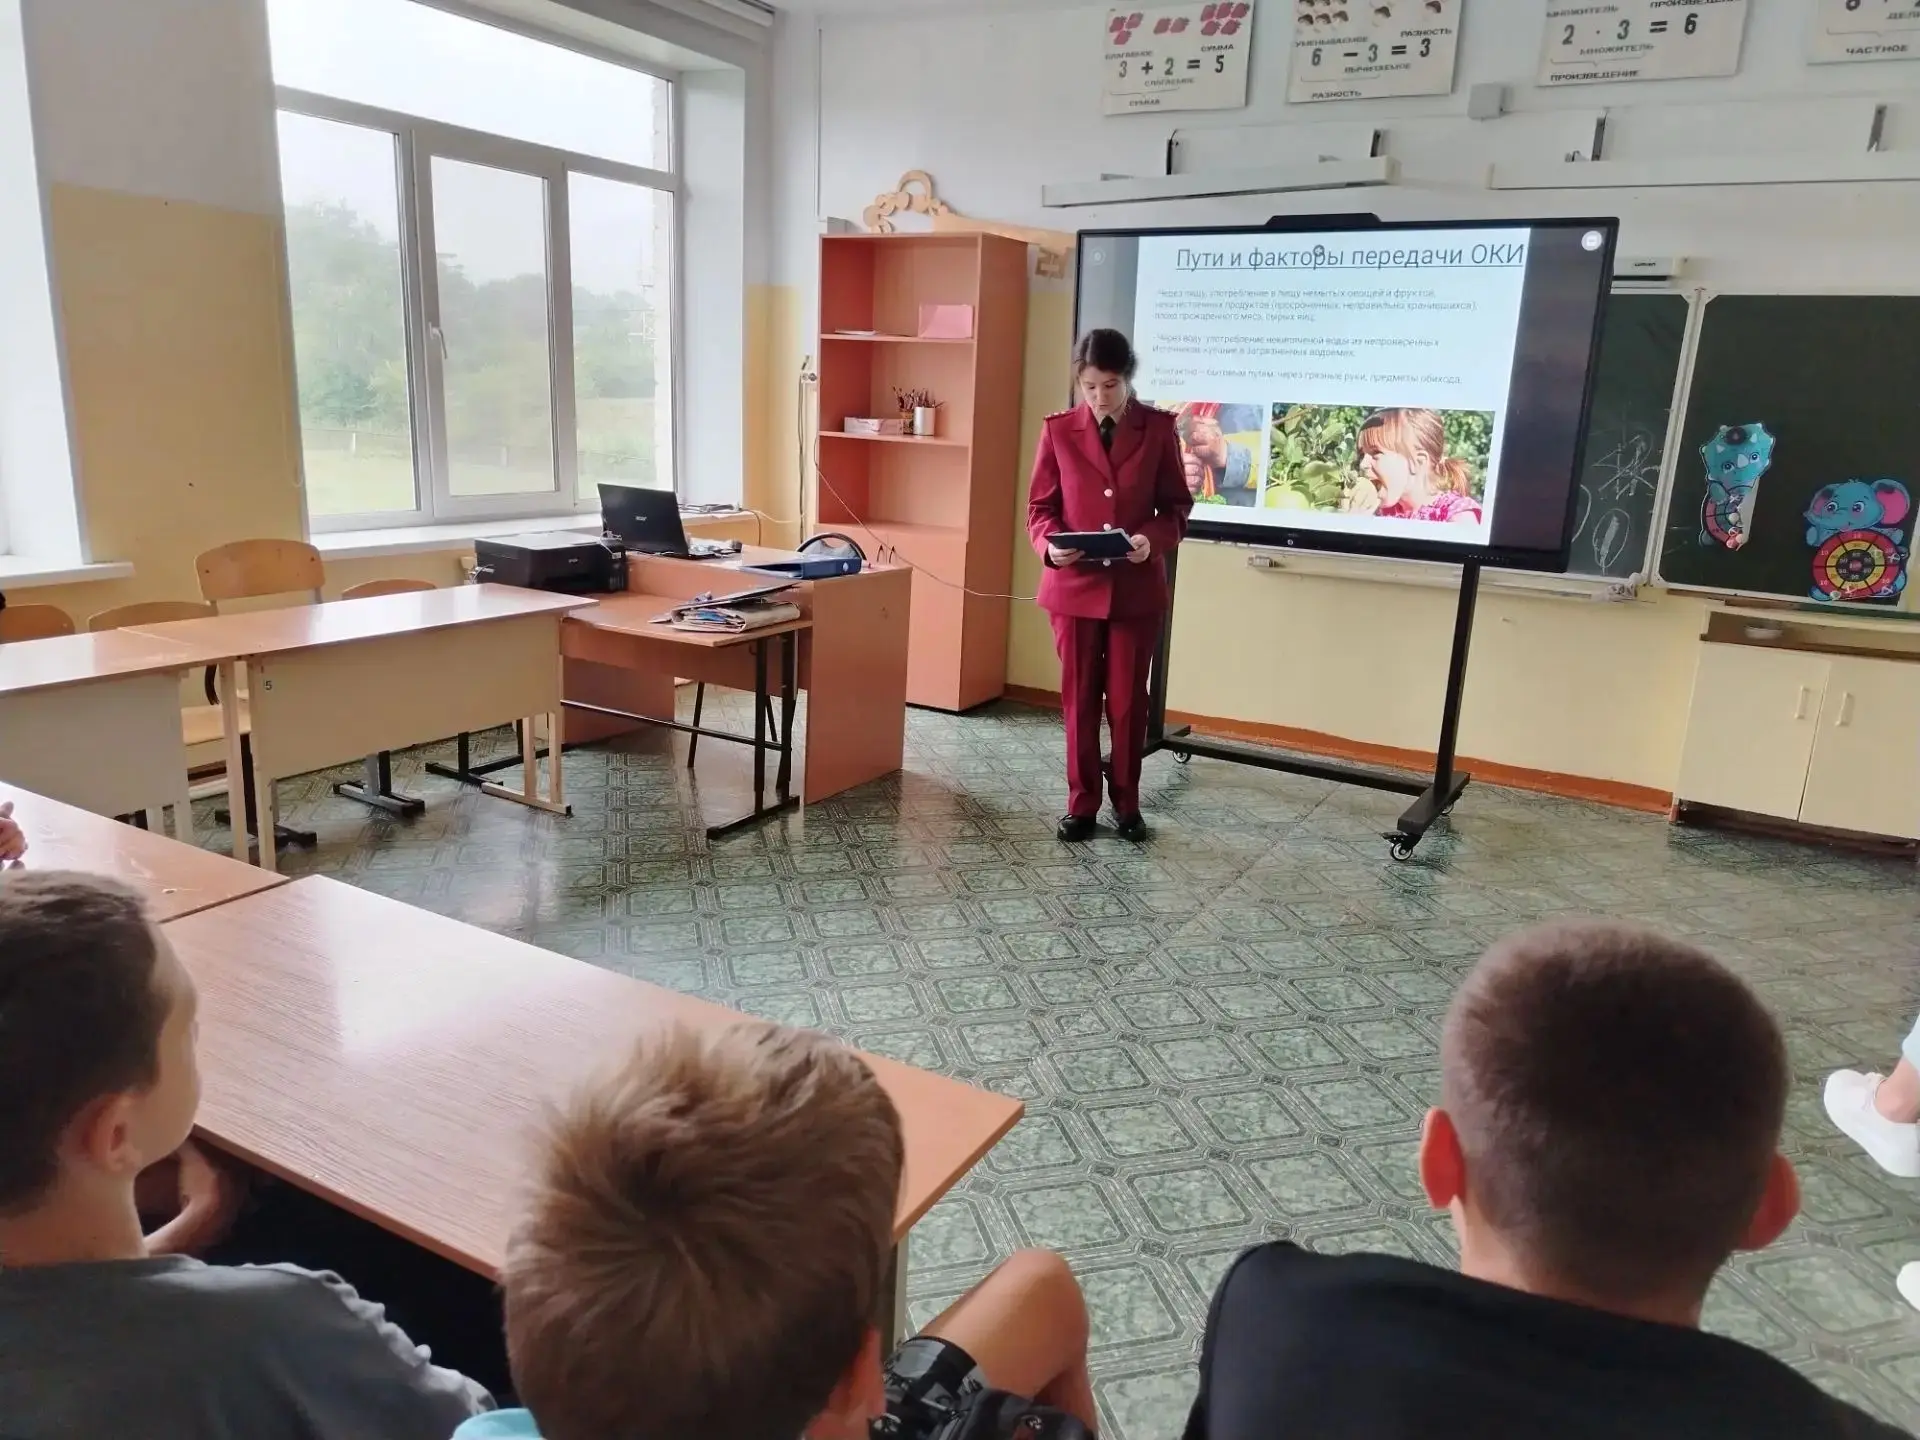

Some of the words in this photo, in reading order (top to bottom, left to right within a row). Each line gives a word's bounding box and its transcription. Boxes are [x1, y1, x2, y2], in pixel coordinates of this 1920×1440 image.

[1400, 27, 1452, 37] РАЗНОСТЬ
[1562, 24, 1575, 45] 2
[1617, 19, 1630, 40] 3
[1684, 13, 1698, 35] 6
[1201, 43, 1235, 52] СУММА
[1311, 48, 1322, 67] 6
[1368, 44, 1379, 63] 3
[1419, 38, 1431, 58] 3
[1845, 44, 1908, 55] ЧАСТНОЕ
[1118, 60, 1128, 78] 3
[1164, 57, 1175, 76] 2
[1214, 55, 1225, 73] 5
[1550, 69, 1640, 82] ПРОИЗВЕДЕНИЕ
[1311, 90, 1362, 100] РАЗНОСТЬ
[1177, 249, 1223, 272] Пути
[1230, 252, 1241, 266] и
[1248, 247, 1343, 270] факторы
[1352, 249, 1462, 270] передачи
[1471, 243, 1524, 264] ОКИ
[265, 680, 273, 691] 5
